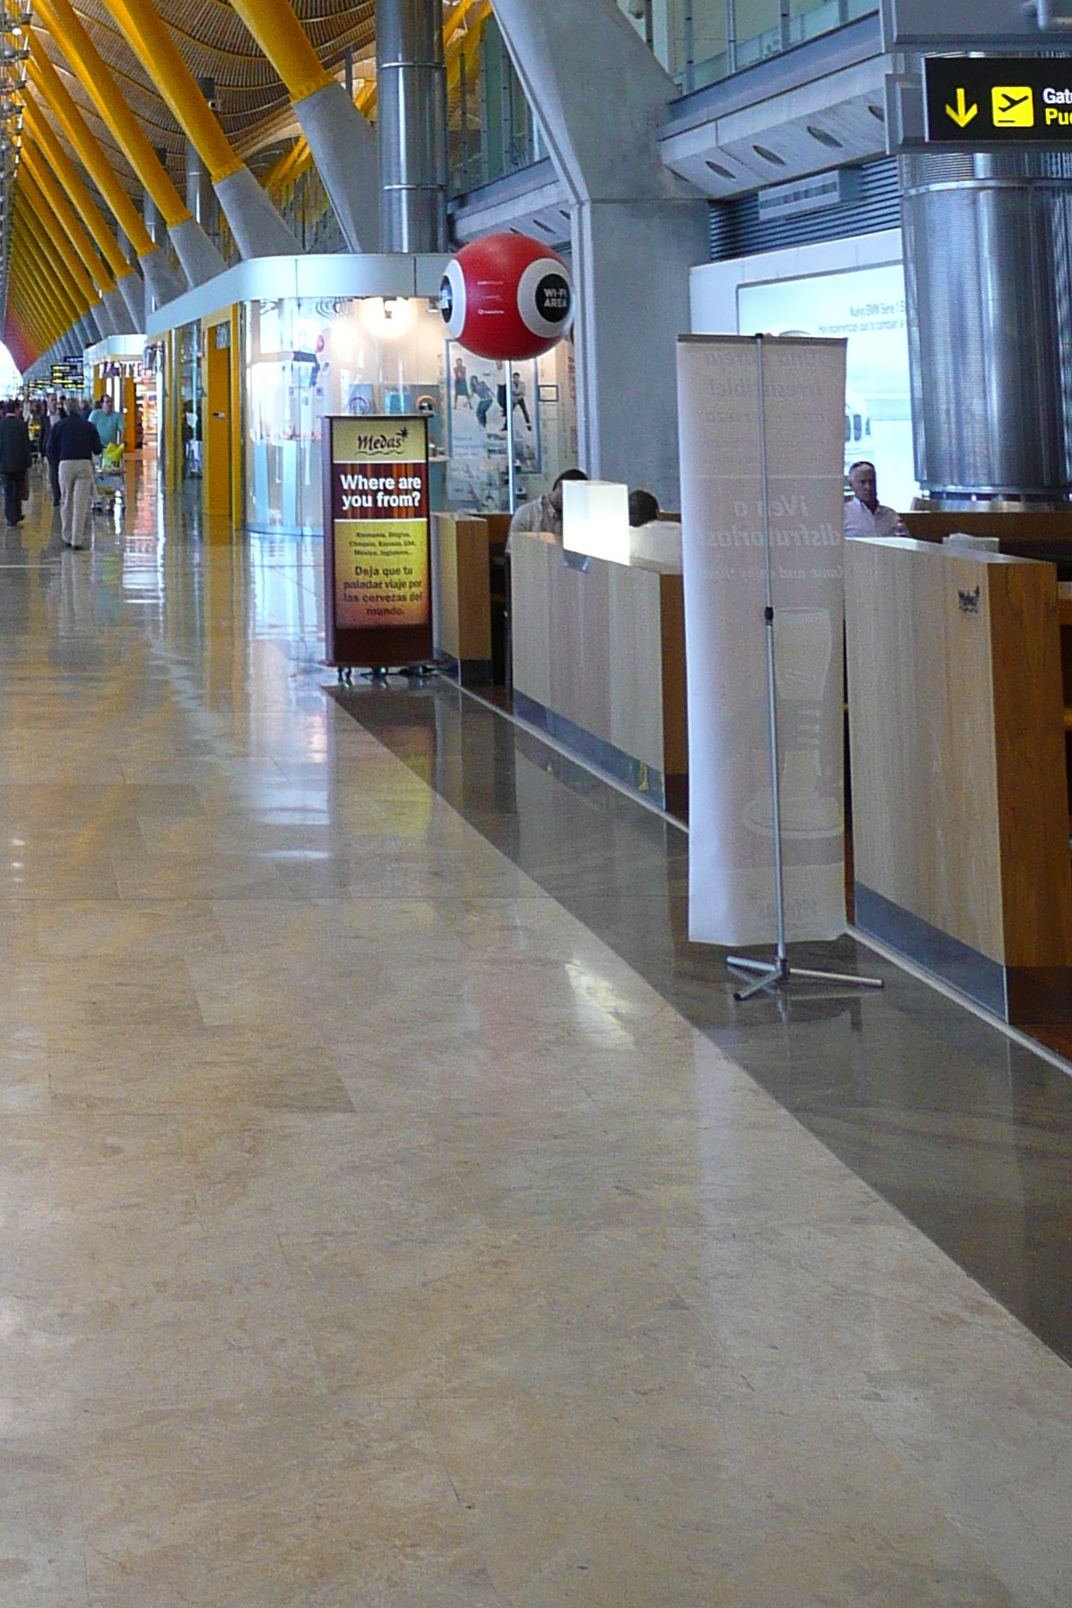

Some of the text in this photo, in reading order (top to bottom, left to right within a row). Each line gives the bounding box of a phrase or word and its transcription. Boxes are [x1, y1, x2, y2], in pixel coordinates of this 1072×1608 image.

[1042, 87, 1072, 104] Gat
[543, 298, 567, 308] AREA
[357, 434, 402, 450] Medas
[340, 474, 421, 490] Where are
[342, 491, 421, 510] you from?
[355, 566, 413, 577] Deja que tu
[343, 579, 422, 590] paladar viaje por
[343, 592, 422, 603] las cervezas del
